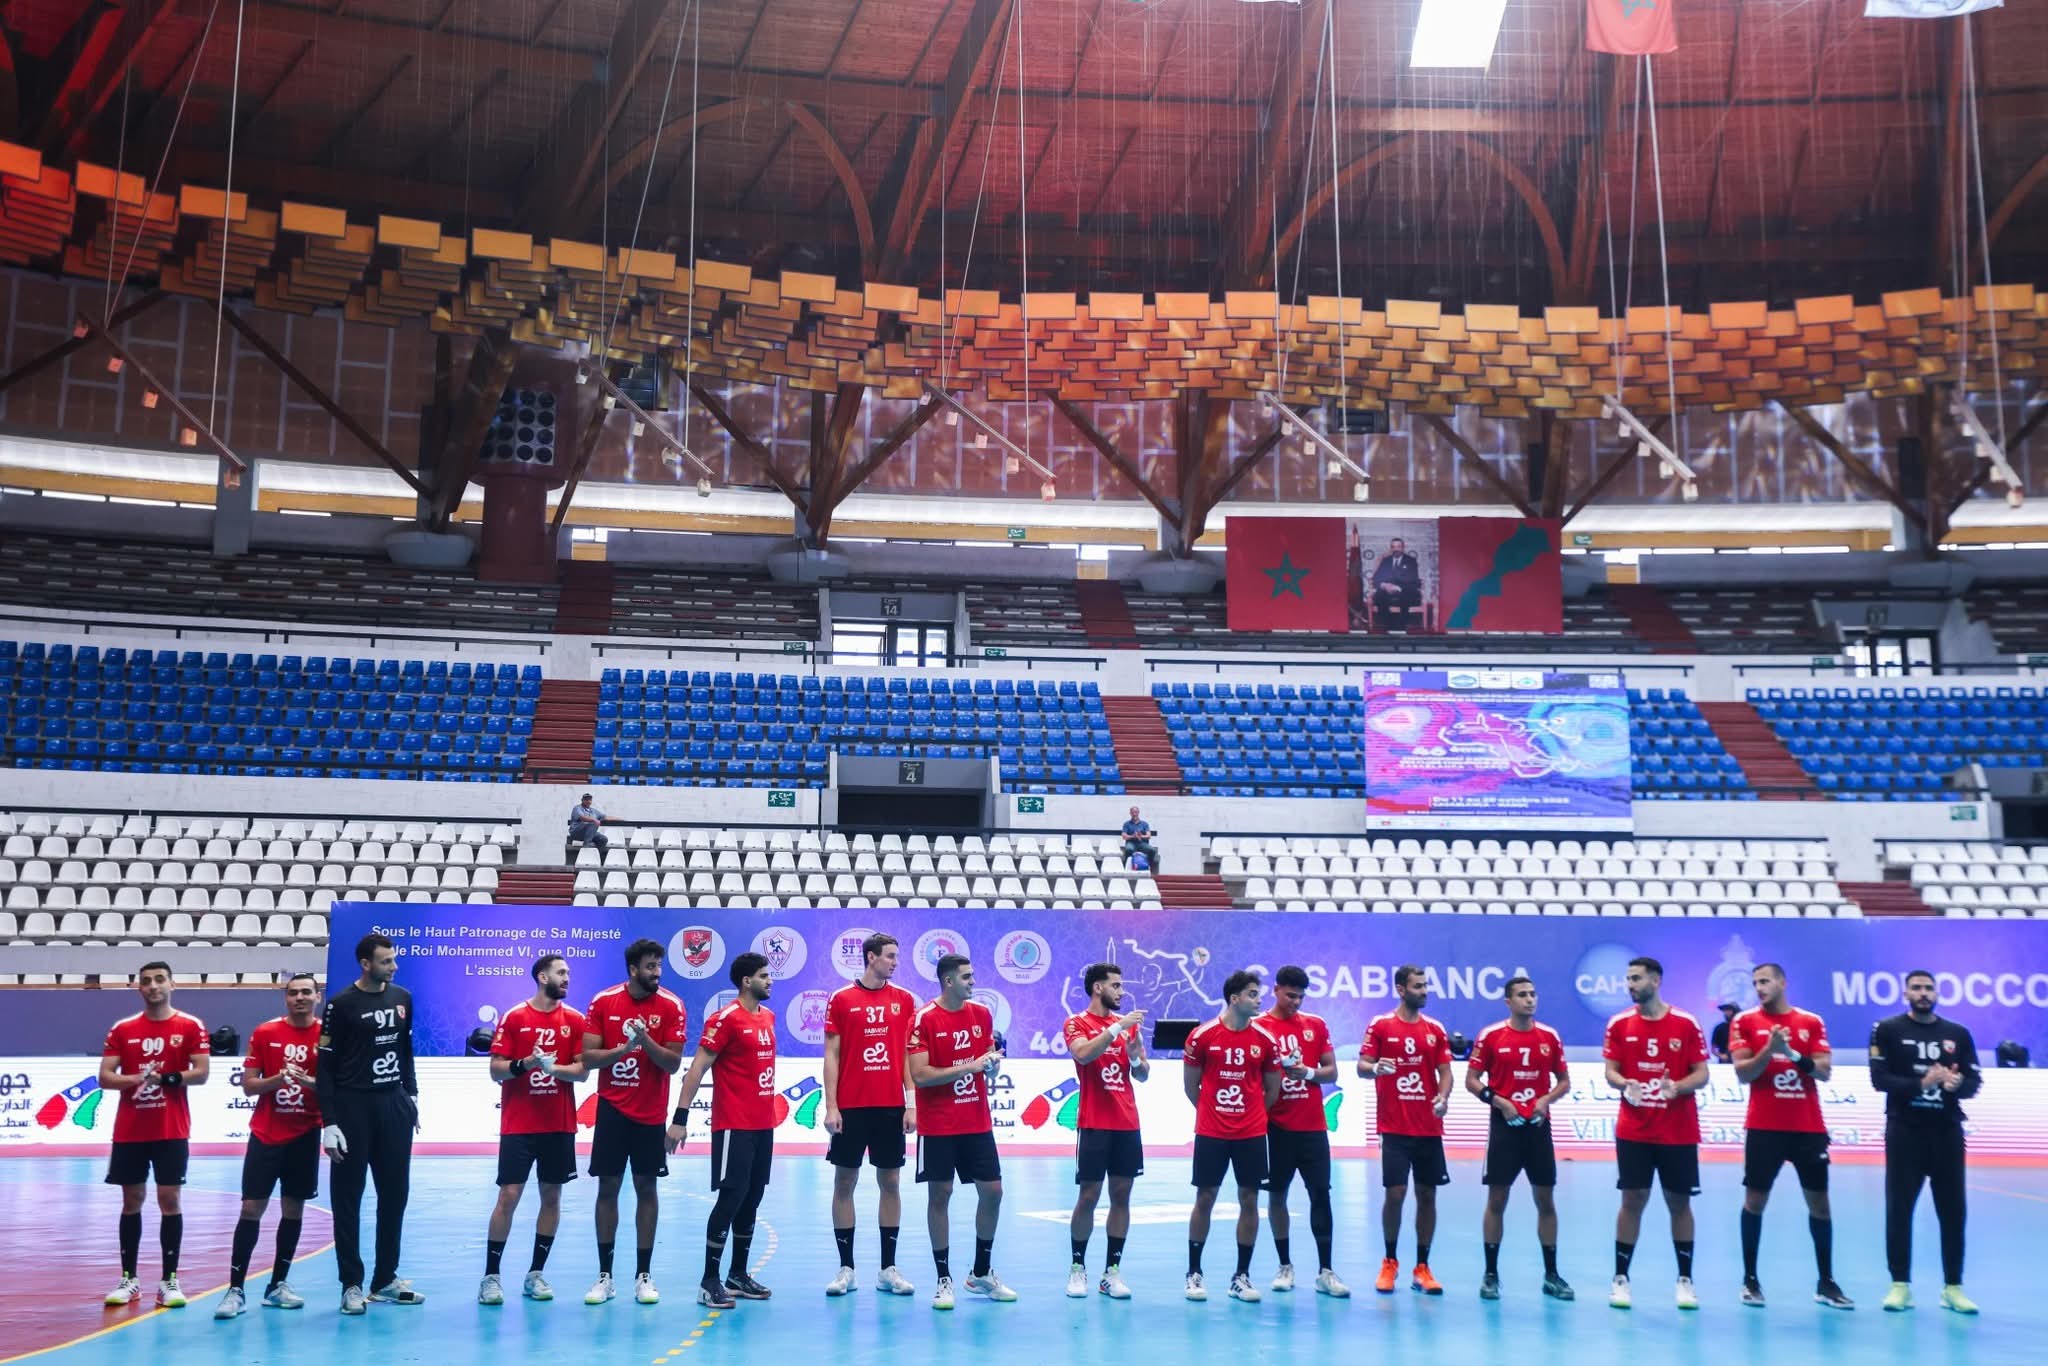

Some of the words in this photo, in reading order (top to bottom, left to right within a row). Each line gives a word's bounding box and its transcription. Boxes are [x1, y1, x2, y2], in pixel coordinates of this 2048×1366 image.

[884, 605, 897, 616] 14
[905, 771, 917, 783] 4
[372, 925, 406, 937] Sous
[410, 926, 421, 937] le
[425, 926, 456, 938] Haut
[459, 926, 527, 941] Patronage
[530, 928, 547, 938] de
[550, 928, 567, 938] Sa
[571, 928, 621, 942] Majesté
[411, 945, 433, 956] Roi
[437, 945, 513, 957] Mohammed
[566, 946, 596, 958] Dieu
[465, 964, 525, 976] L'assiste
[1575, 974, 1628, 995] CAH
[1832, 971, 2048, 1008] MOOCCO
[374, 1009, 396, 1029] 97
[865, 1006, 886, 1024] 37
[142, 1036, 165, 1057] 99
[535, 1028, 556, 1046] 72
[757, 1028, 772, 1046] 44
[953, 1030, 971, 1050] 22
[1404, 1036, 1416, 1055] 8
[284, 1044, 309, 1063] 98
[1224, 1047, 1245, 1066] 13
[1519, 1047, 1531, 1066] 7
[1646, 1038, 1658, 1057] 5
[1917, 1041, 1941, 1060] 16
